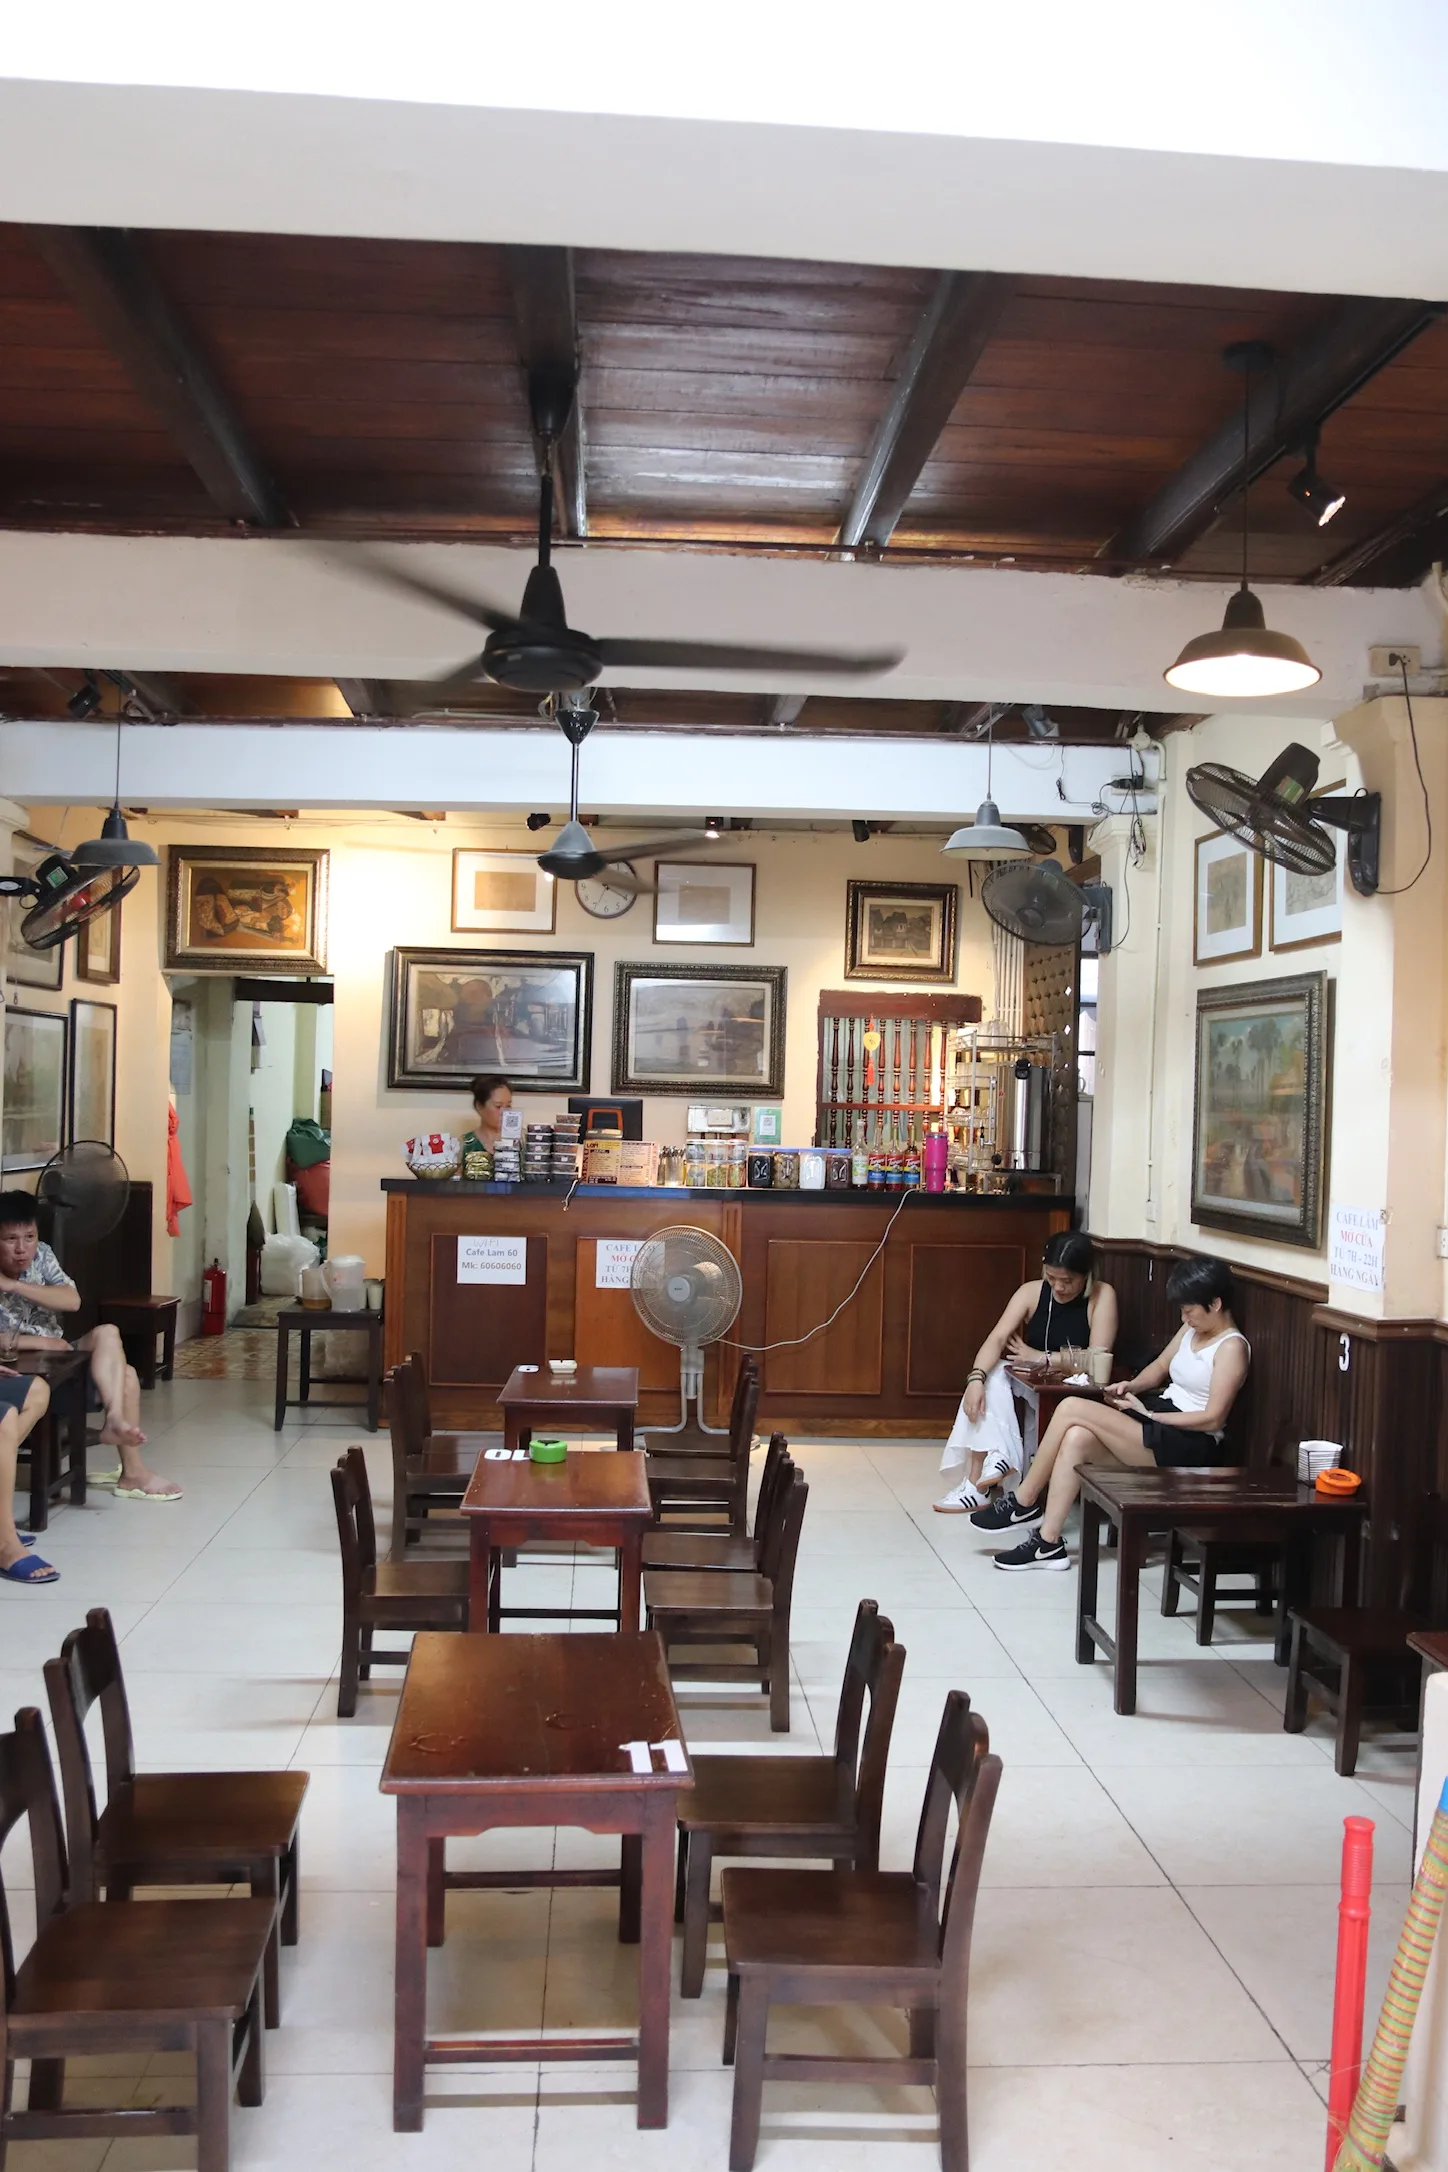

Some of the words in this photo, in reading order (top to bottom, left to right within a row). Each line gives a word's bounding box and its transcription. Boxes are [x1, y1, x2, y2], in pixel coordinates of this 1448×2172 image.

[603, 904, 609, 913] 6
[582, 1148, 590, 1182] MENU
[1336, 1211, 1358, 1226] CAFE
[466, 1248, 485, 1257] Cafe
[487, 1248, 505, 1257] Lam
[507, 1249, 518, 1257] 60
[605, 1243, 631, 1252] CAFE
[1347, 1249, 1357, 1262] 7H
[1363, 1253, 1378, 1268] 22H
[461, 1261, 478, 1269] Mk:
[480, 1262, 522, 1270] 60606060
[601, 1273, 629, 1283] HÀNG
[1338, 1332, 1350, 1371] 3
[618, 1739, 688, 1773] 11
